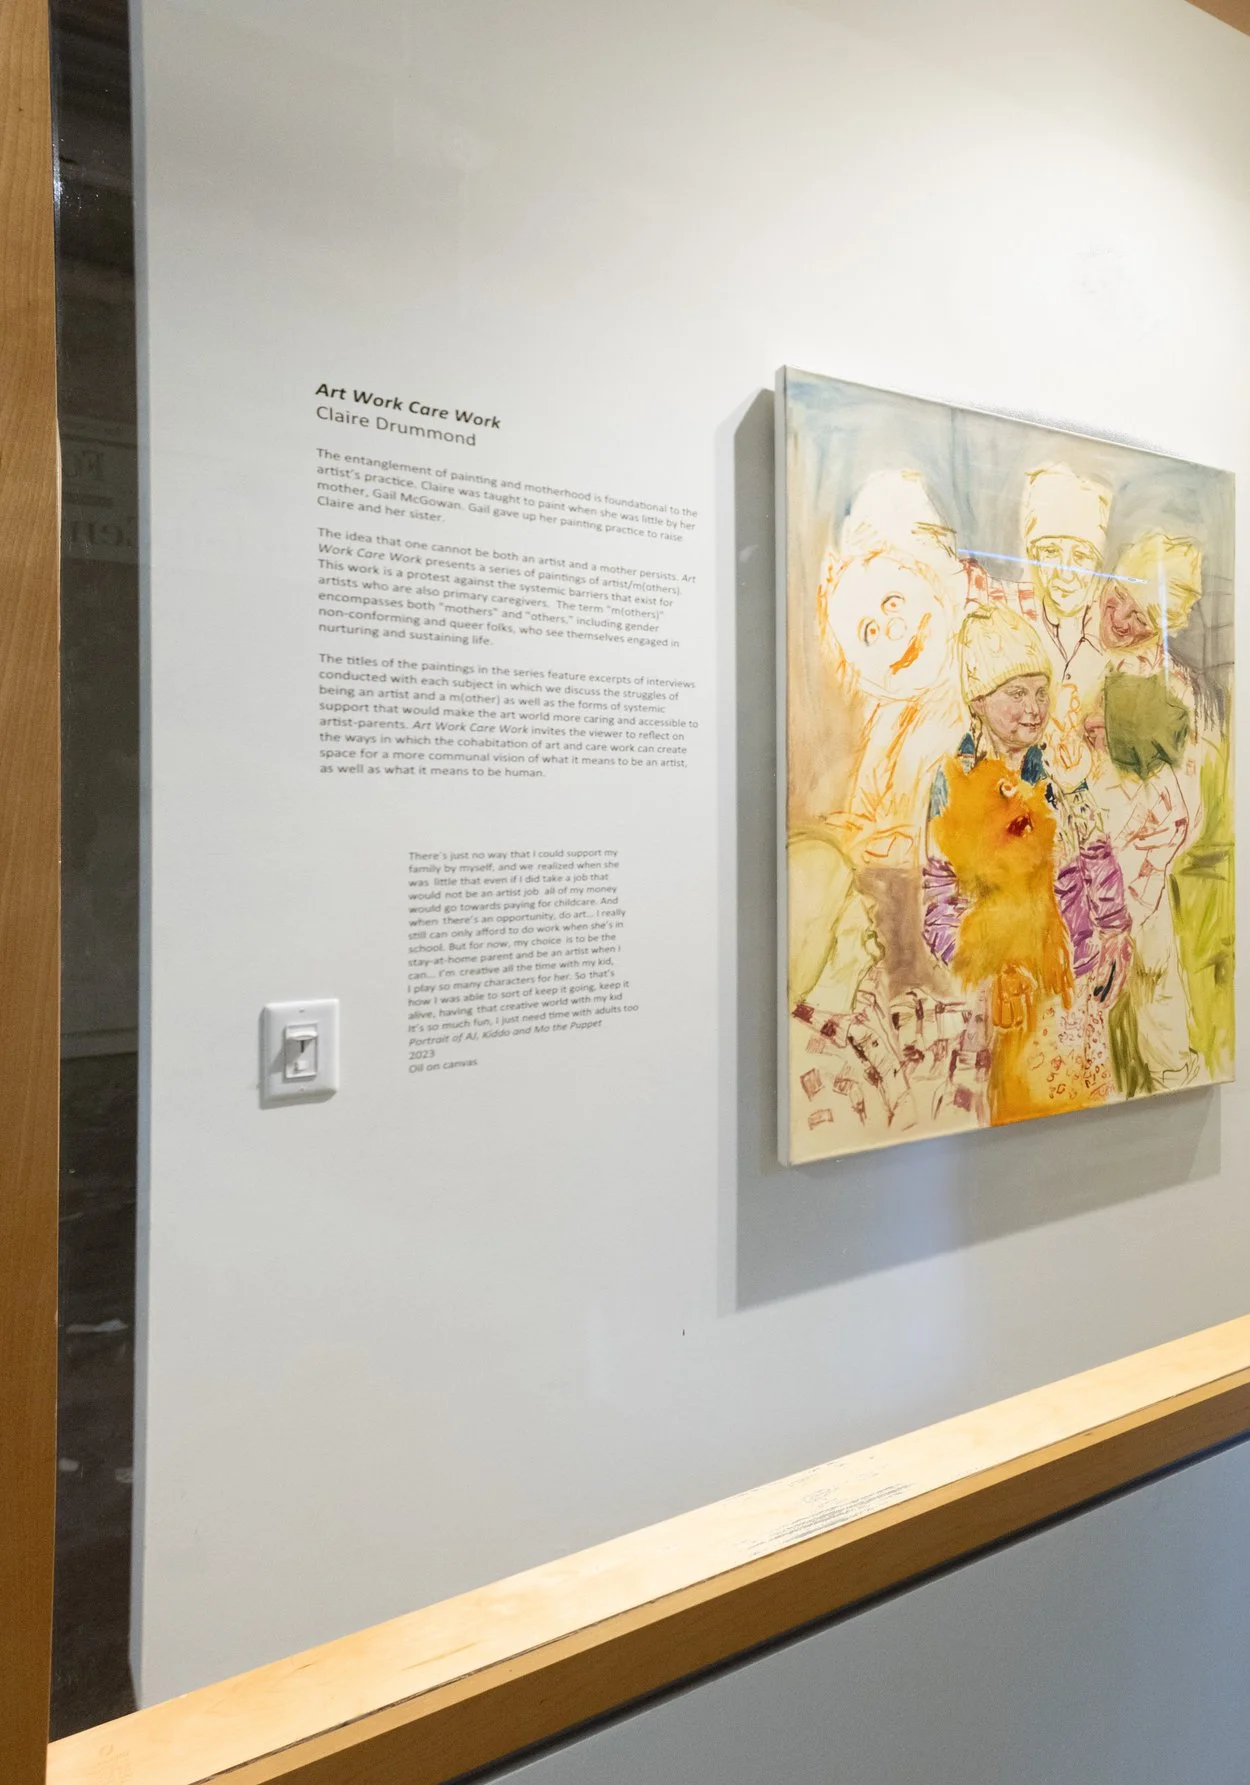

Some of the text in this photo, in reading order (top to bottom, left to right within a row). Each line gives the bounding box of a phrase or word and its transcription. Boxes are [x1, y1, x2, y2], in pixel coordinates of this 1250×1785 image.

[316, 382, 500, 428] Art Work Care Work
[316, 407, 476, 446] Claire Drummond
[317, 448, 698, 517] The entanglement of painting and motherhood is foundational to the
[317, 495, 355, 510] Claire
[358, 503, 382, 514] and
[385, 505, 406, 517] her
[372, 488, 398, 501] Gail
[468, 502, 491, 514] Gail
[493, 508, 520, 518] gave
[522, 513, 537, 523] up
[539, 513, 557, 524] her
[560, 518, 603, 533] painting
[605, 525, 645, 536] practice
[647, 530, 658, 538] to
[660, 532, 683, 542] raise
[421, 480, 455, 494] Claire
[458, 488, 481, 498] was
[483, 491, 521, 505] taught
[523, 497, 536, 507] to
[538, 500, 566, 511] paint
[568, 504, 598, 516] when
[600, 508, 618, 519] she
[620, 513, 640, 522] was
[642, 514, 664, 526] little
[666, 518, 678, 530] by
[680, 520, 695, 530] her
[318, 593, 404, 608] encompasses
[406, 599, 436, 611] both
[501, 610, 523, 619] and
[576, 616, 623, 631] including
[624, 623, 659, 632] gender
[318, 624, 380, 638] nurturing
[383, 628, 407, 638] and
[409, 632, 470, 646] sustaining
[320, 653, 695, 689] The titles of the paintings in the series feature excerpts of interviews
[337, 764, 365, 773] well
[384, 765, 415, 774] what
[418, 765, 427, 775] it
[472, 768, 485, 776] to
[487, 767, 502, 776] be
[450, 851, 469, 861] just
[487, 852, 508, 860] way
[510, 850, 531, 858] that
[533, 850, 537, 858] I
[538, 849, 565, 858] could
[566, 849, 602, 859] support
[604, 850, 618, 858] my
[408, 864, 441, 874] family
[443, 864, 457, 874] by
[498, 863, 518, 871] and
[537, 861, 575, 870] realized
[576, 861, 602, 869] when
[604, 860, 620, 868] she
[408, 931, 427, 940] still
[451, 929, 473, 938] only
[475, 927, 507, 936] afford
[521, 925, 535, 933] do
[536, 924, 561, 933] work
[562, 923, 589, 931] when
[615, 920, 624, 928] in
[480, 952, 514, 964] parent
[516, 950, 535, 959] and
[536, 950, 549, 958] be
[565, 947, 589, 956] artist
[591, 945, 616, 954] when
[618, 944, 621, 952] I
[409, 1034, 450, 1046] Portrait
[451, 1033, 464, 1042] of
[482, 1029, 511, 1039] Kiddo
[512, 1026, 533, 1035] and
[534, 1025, 551, 1033] Mo
[552, 1023, 568, 1031] the
[570, 1019, 602, 1030] Puppet
[409, 1049, 436, 1060] 2023
[408, 1063, 425, 1073] Oil
[443, 1059, 478, 1069] canvas
